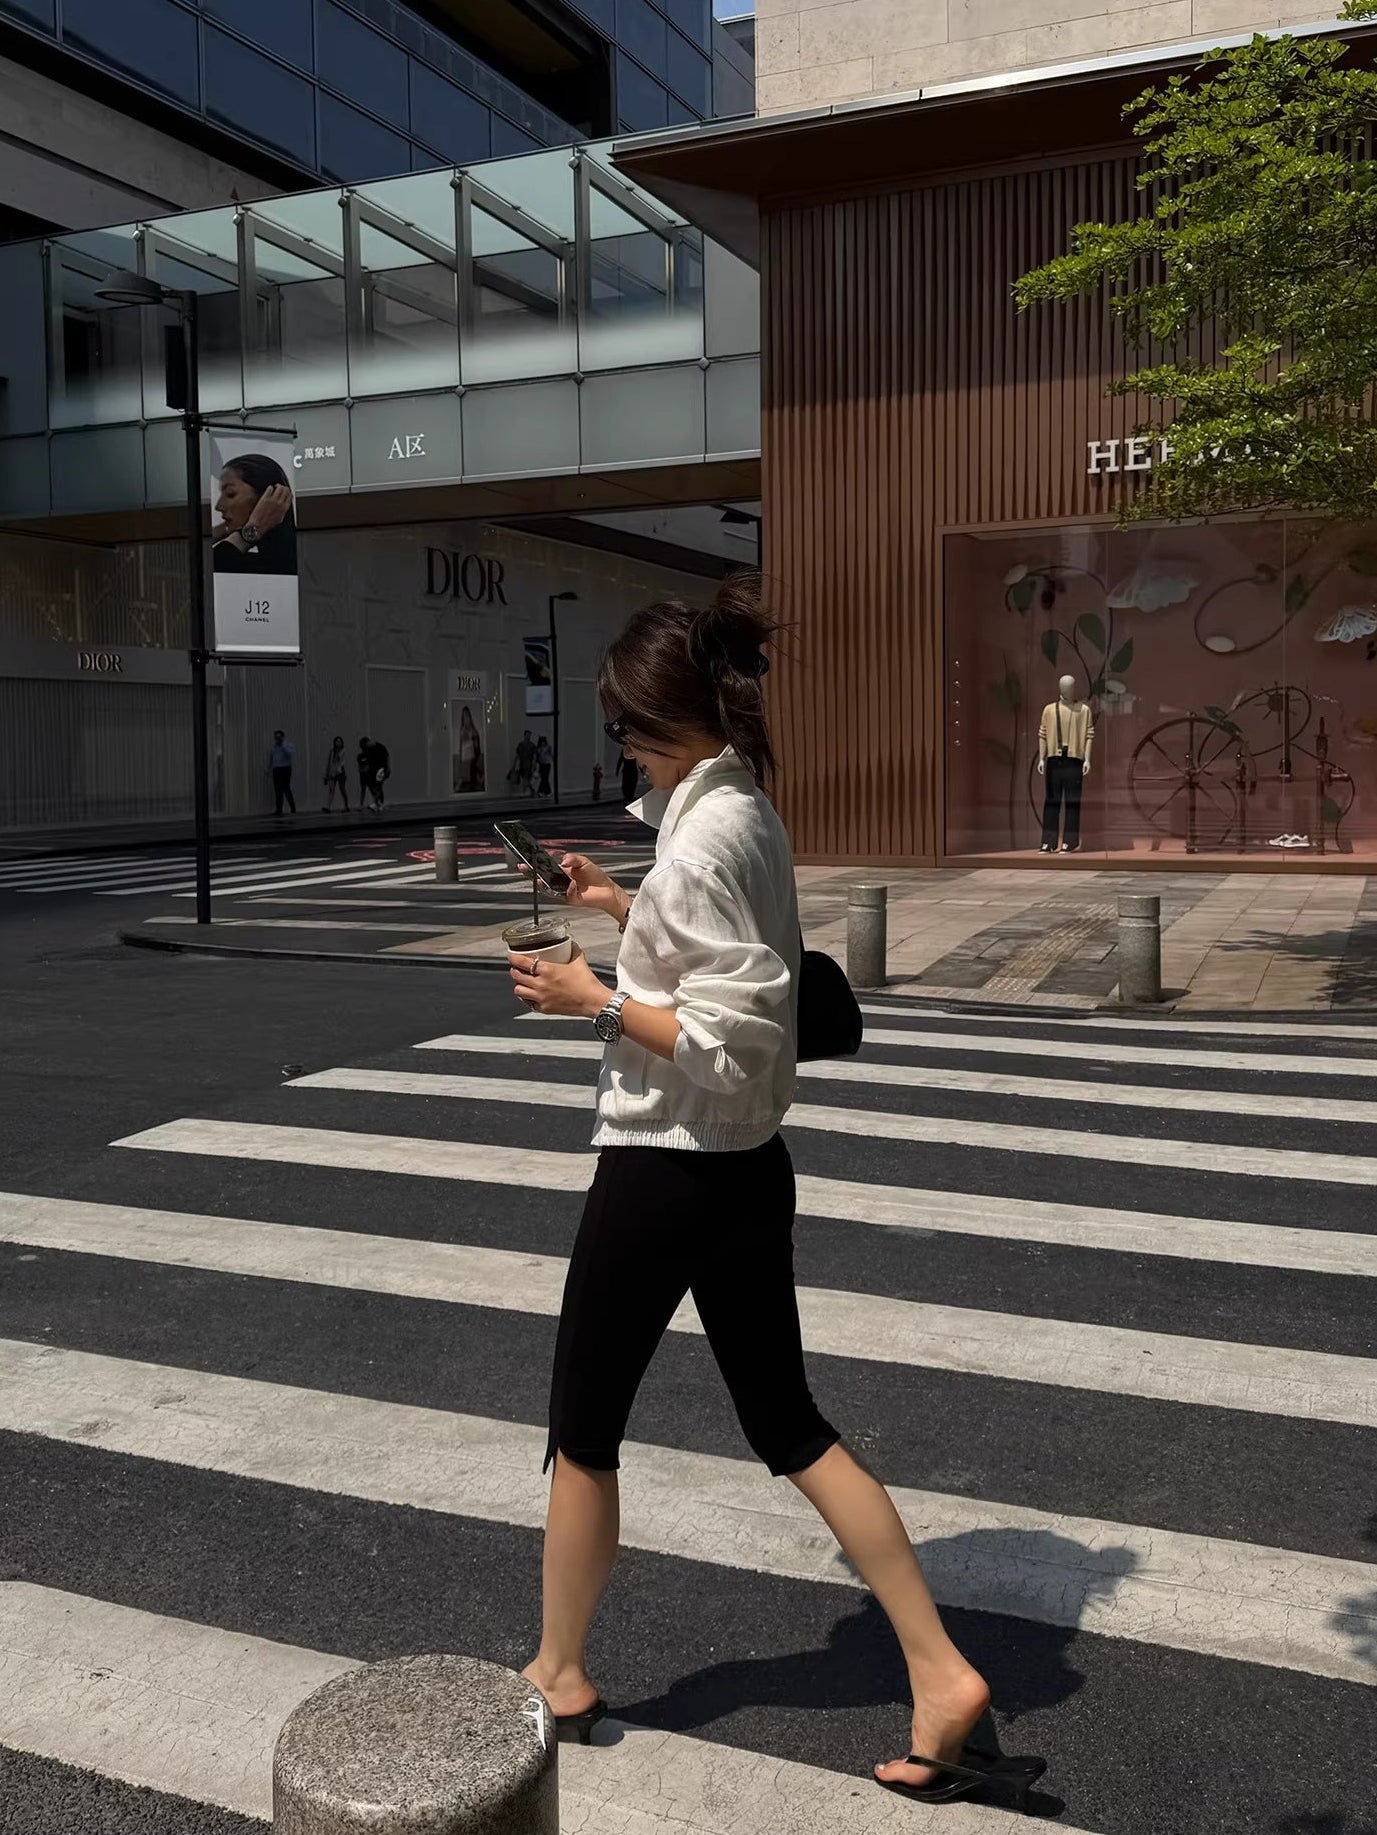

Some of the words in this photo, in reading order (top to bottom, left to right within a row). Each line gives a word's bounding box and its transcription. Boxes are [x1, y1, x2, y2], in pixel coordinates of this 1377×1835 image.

[388, 433, 426, 460] A区
[425, 547, 509, 605] DIOR
[245, 600, 270, 614] J12
[77, 652, 123, 672] DIOR
[457, 676, 481, 690] DIOR
